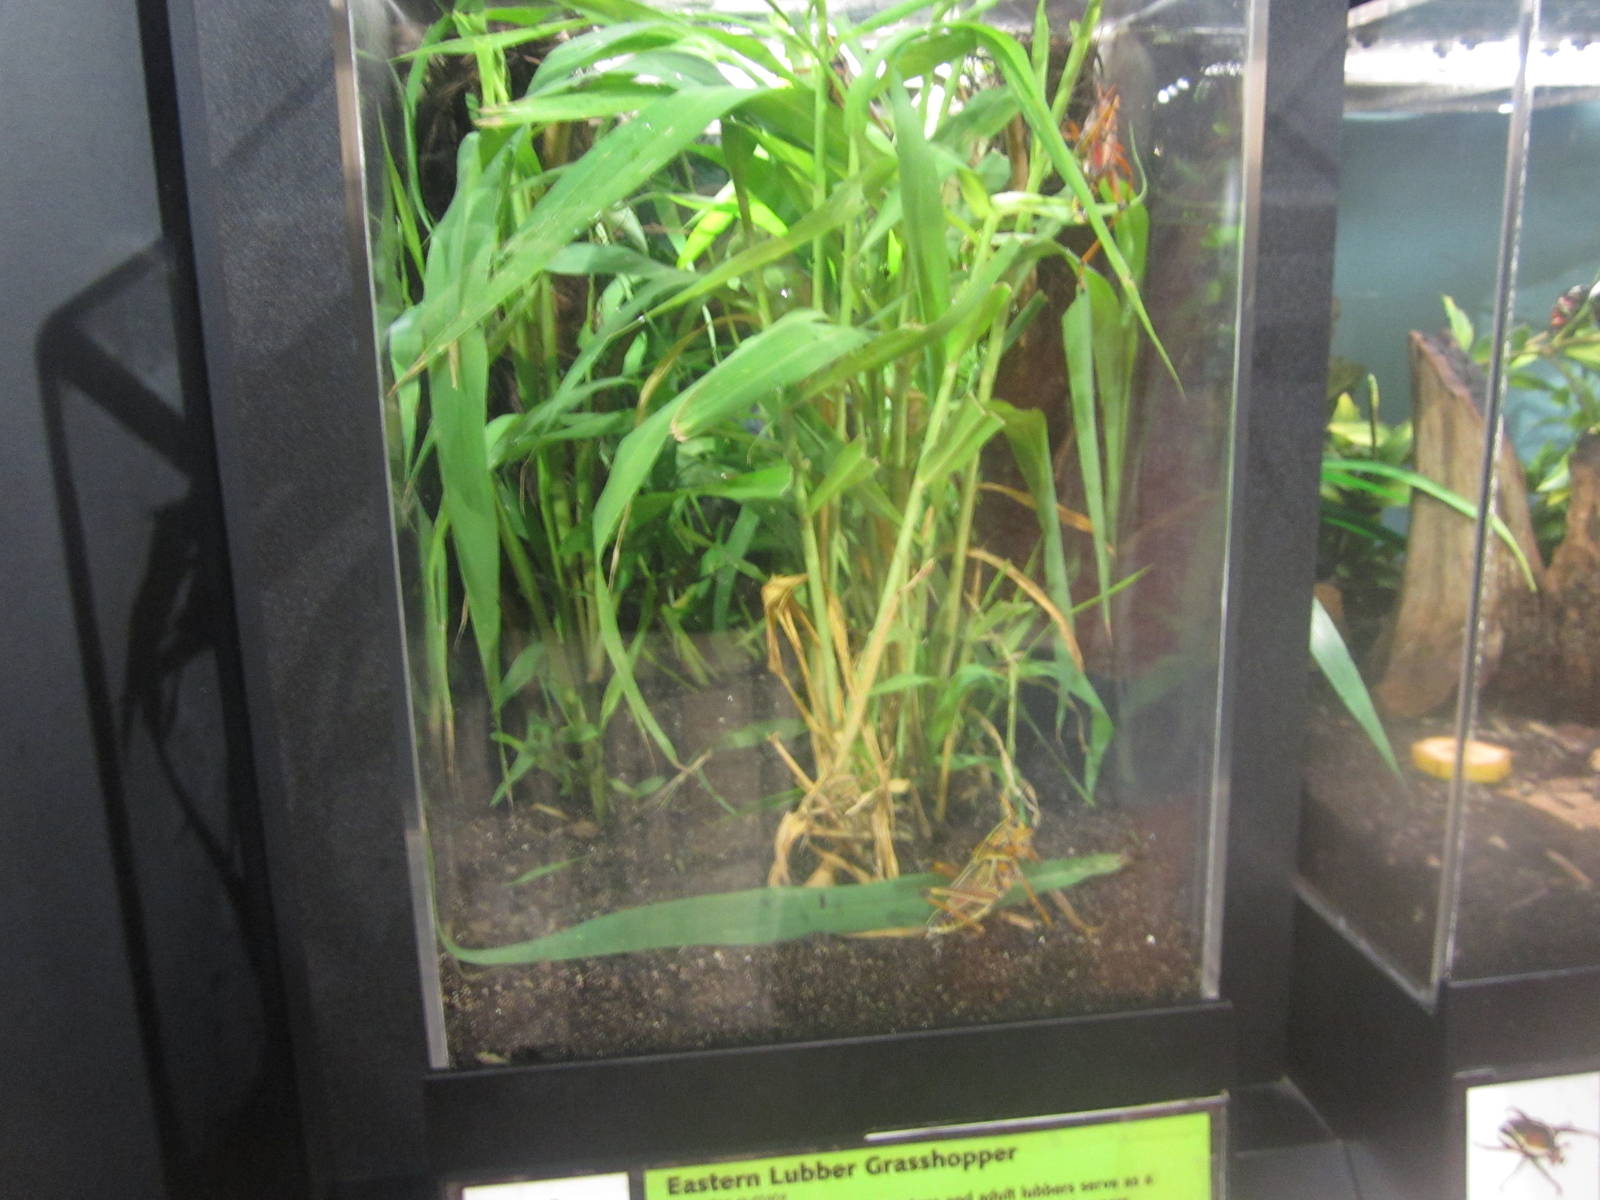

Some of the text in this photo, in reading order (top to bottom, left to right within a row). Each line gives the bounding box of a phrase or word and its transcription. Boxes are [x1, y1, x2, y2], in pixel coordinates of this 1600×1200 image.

[668, 1146, 1017, 1195] Eastern Lubber Grasshopper
